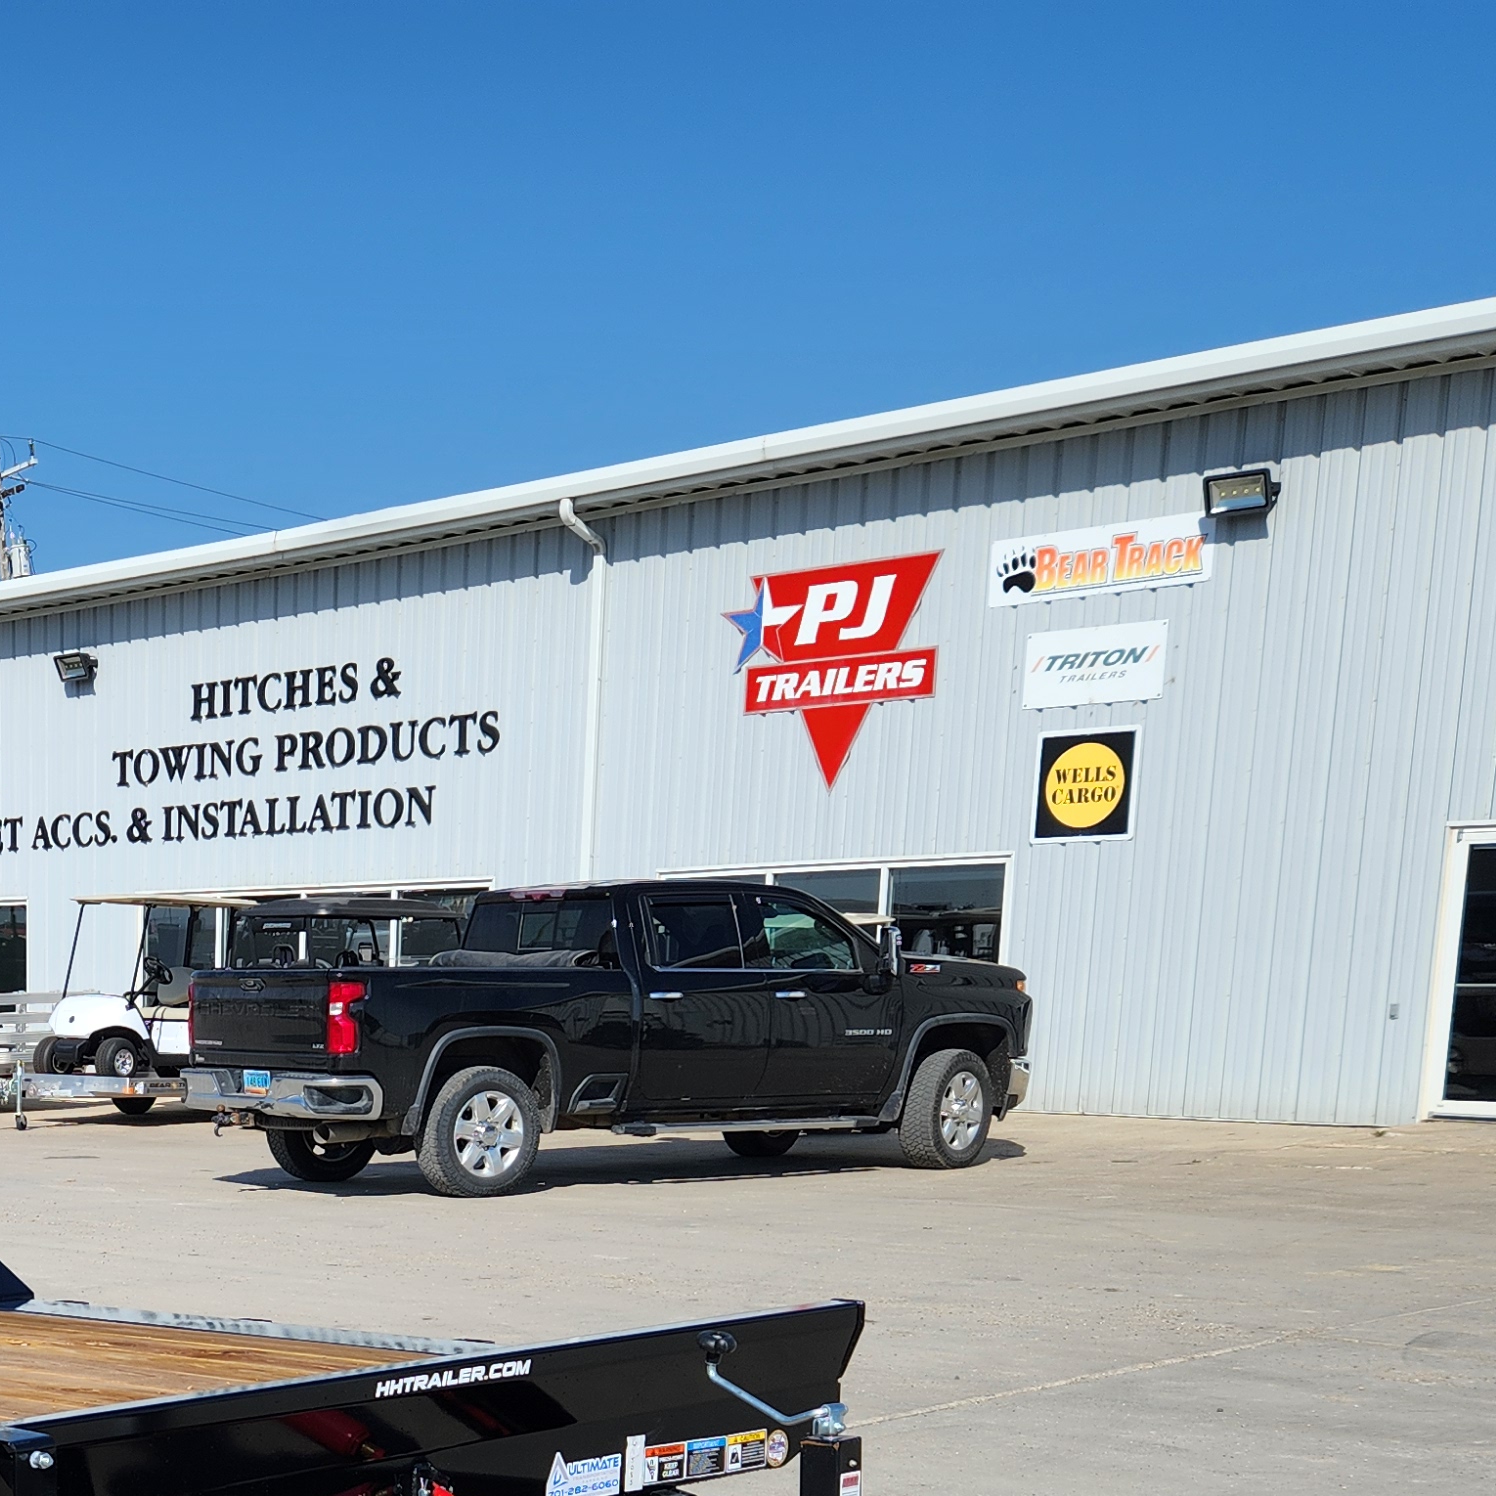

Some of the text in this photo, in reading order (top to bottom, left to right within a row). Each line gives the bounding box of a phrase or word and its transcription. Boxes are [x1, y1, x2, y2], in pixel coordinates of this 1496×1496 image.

[1035, 531, 1208, 592] BEAR TRACK
[794, 574, 897, 645] PJ
[1045, 646, 1149, 672] TRITON
[1060, 669, 1127, 683] TRAILERS
[191, 656, 402, 721] HITCHES &
[755, 658, 927, 702] TRAILERS
[112, 710, 500, 788] TOWING PRODUCTS
[1051, 785, 1117, 805] CARGO
[1055, 765, 1117, 785] WELLS
[31, 810, 118, 851] ACCS.
[126, 807, 153, 844] &
[161, 784, 438, 843] INSTALLATION
[375, 1359, 532, 1398] HHTRAILER.COM
[568, 1456, 620, 1476] ULTIMATE
